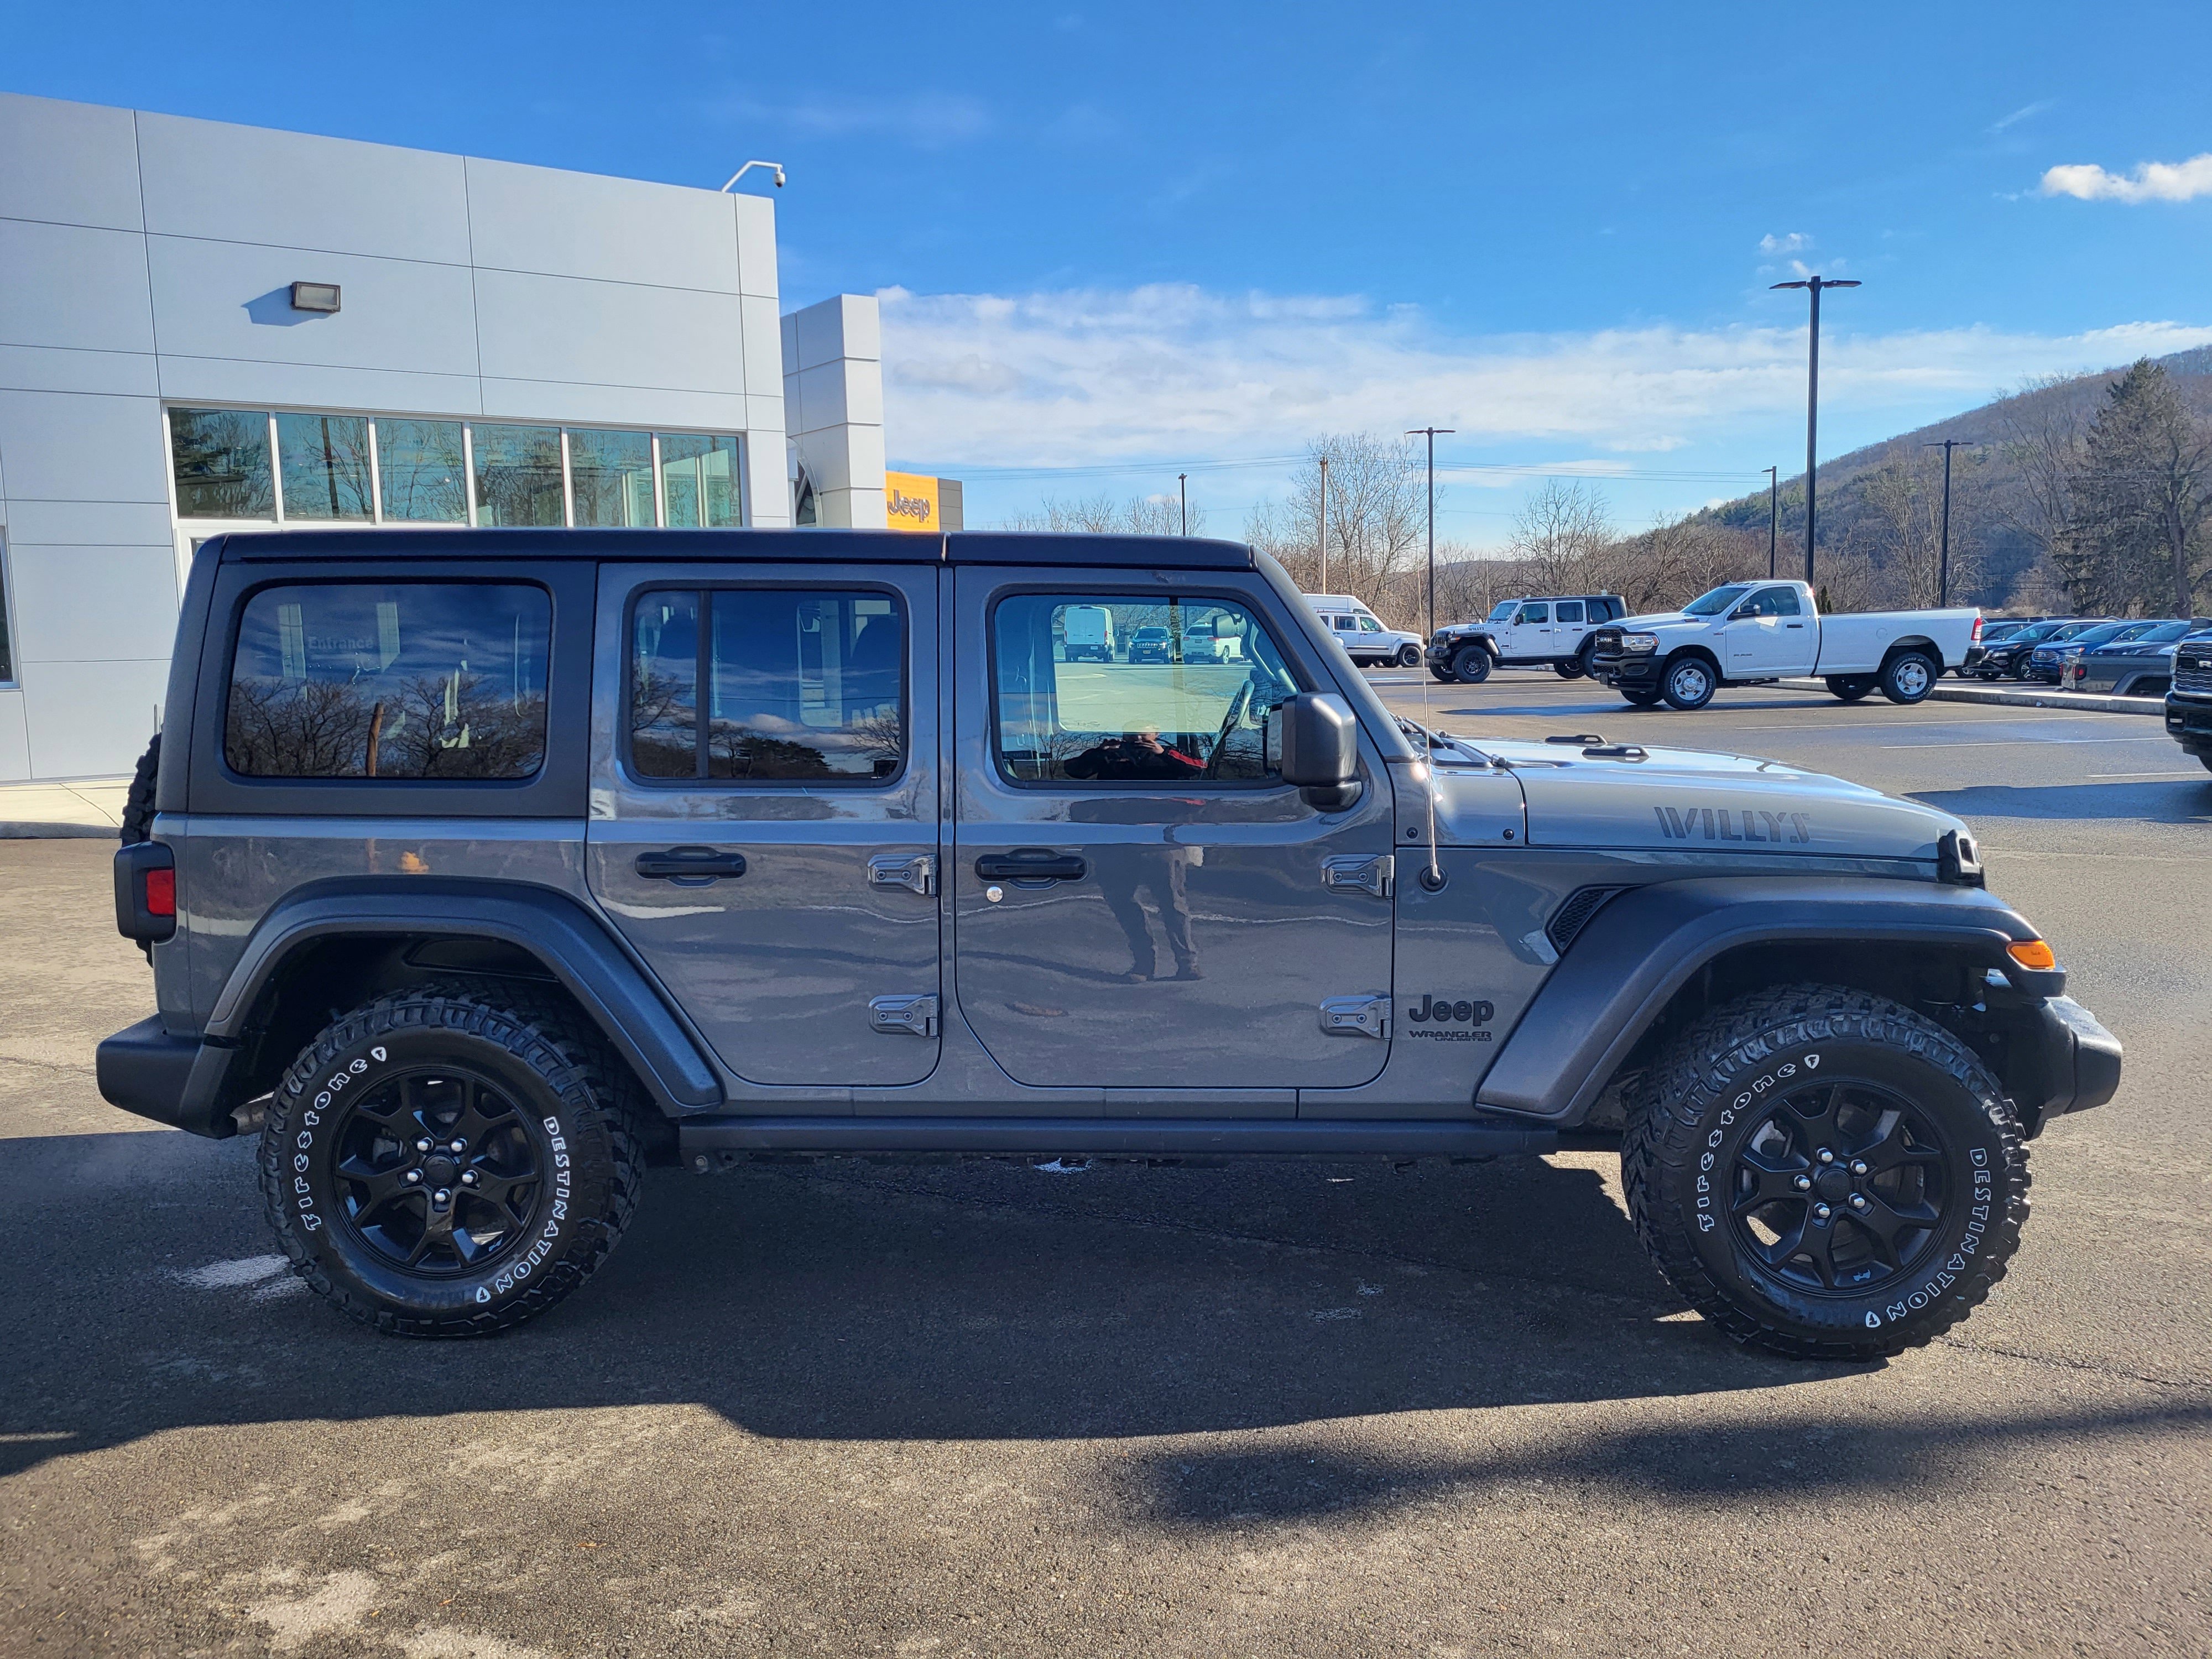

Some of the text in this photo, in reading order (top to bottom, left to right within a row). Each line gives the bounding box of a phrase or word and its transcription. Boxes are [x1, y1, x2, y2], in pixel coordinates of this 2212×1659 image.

[887, 489, 930, 523] Jeep
[308, 636, 374, 649] Entrance
[1654, 806, 1810, 843] WILLYS
[1409, 994, 1494, 1027] Jeep
[294, 1058, 570, 1294] Firestone DESTINATION
[1697, 1063, 1991, 1322] Firestone DESTINATION
